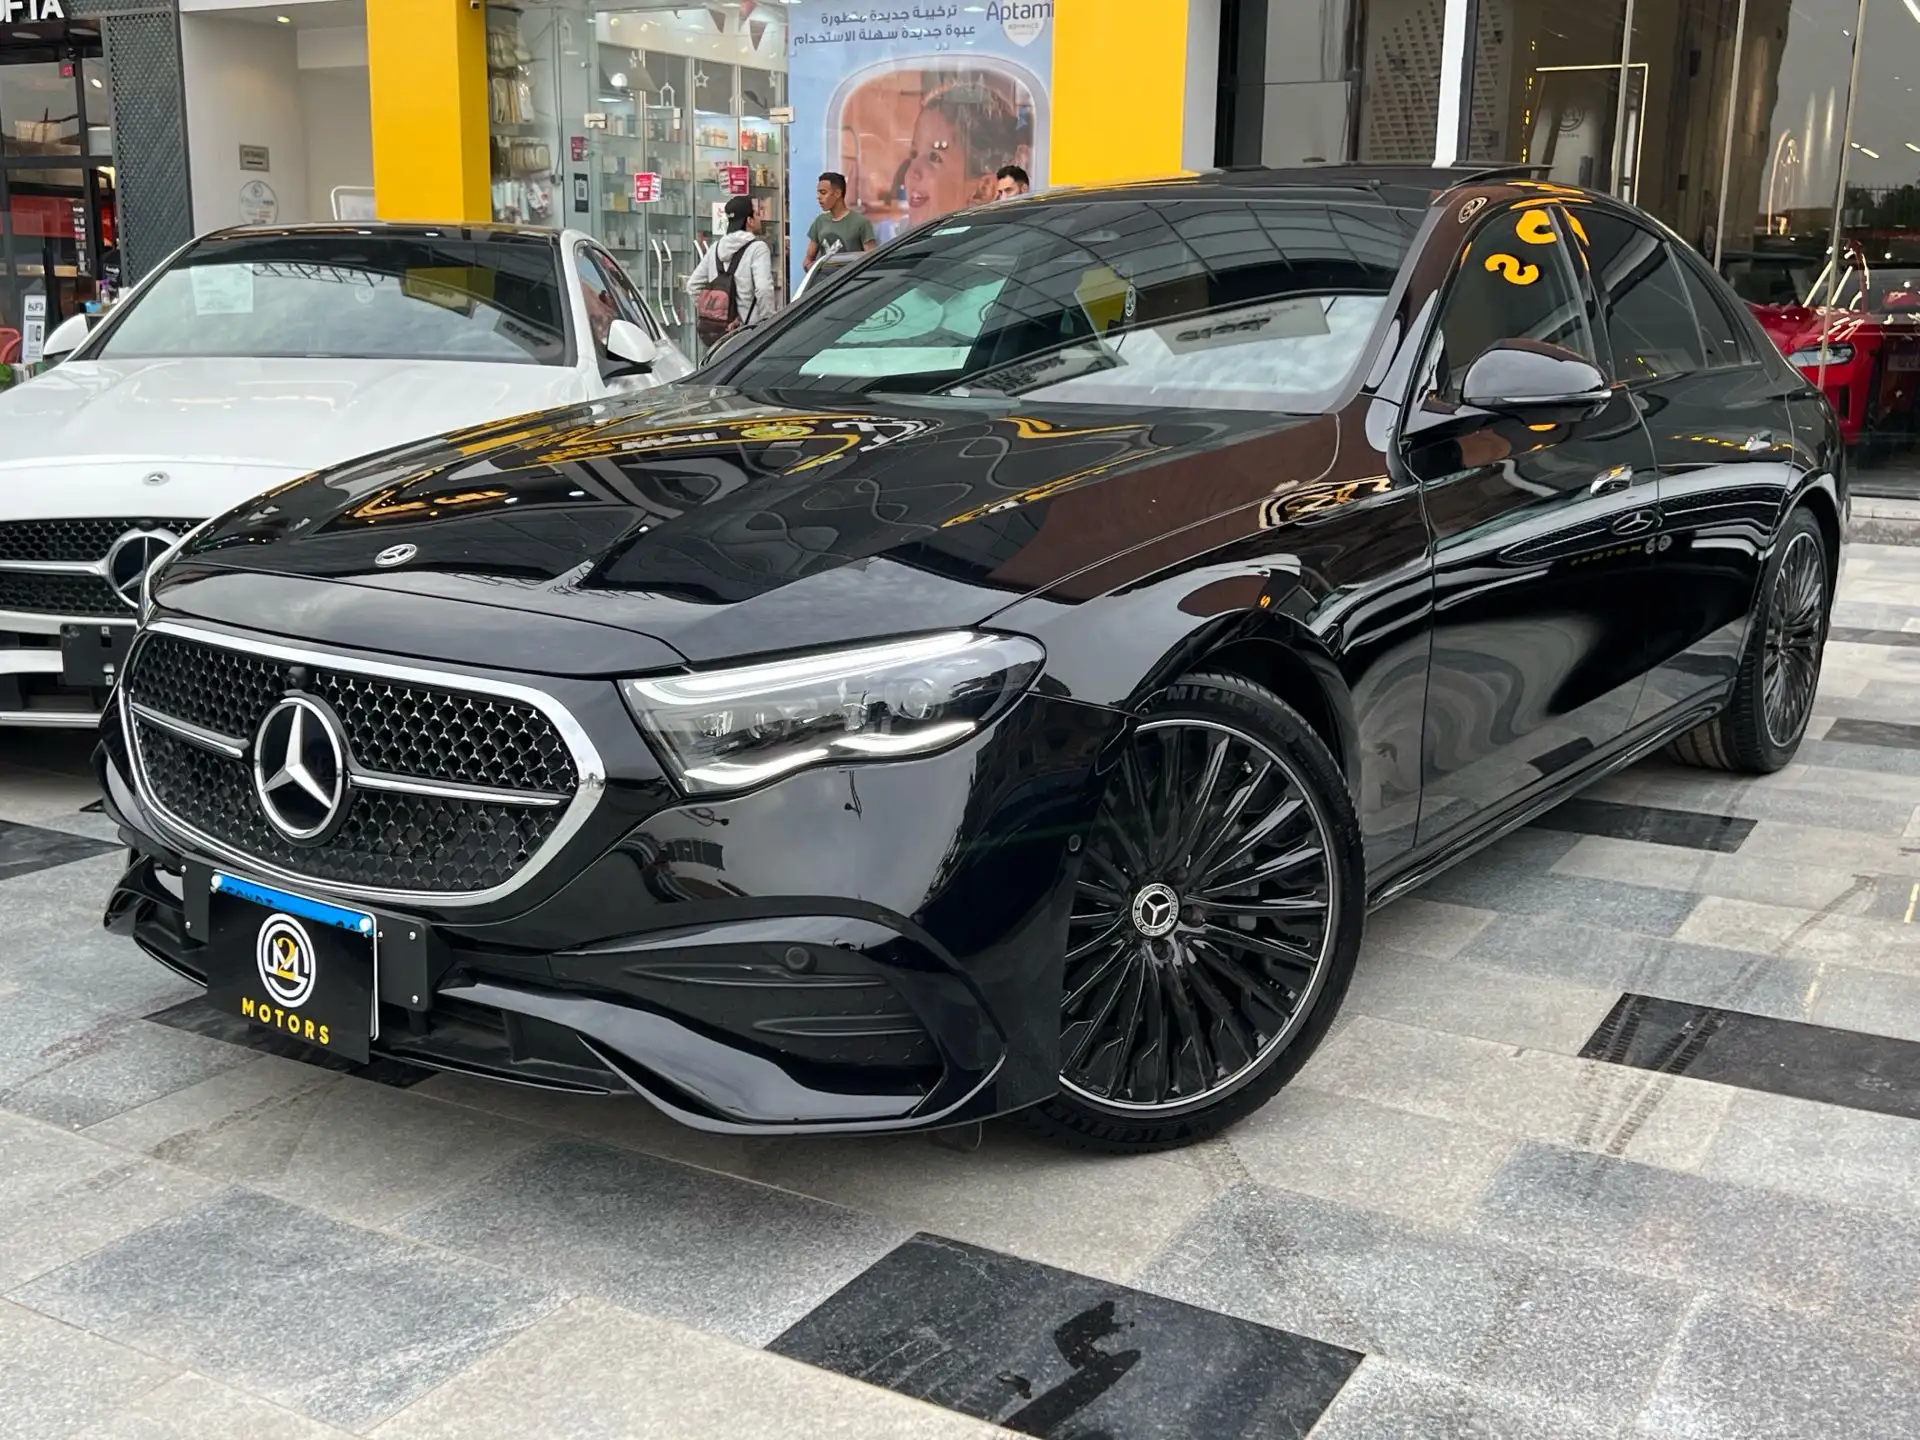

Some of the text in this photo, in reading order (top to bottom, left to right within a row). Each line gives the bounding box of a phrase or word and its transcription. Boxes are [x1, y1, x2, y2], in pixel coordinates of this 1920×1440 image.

[0, 0, 64, 22] FIA
[870, 9, 910, 24] جديدة
[912, 4, 957, 20] تركيبة
[794, 24, 976, 46] عبوة جديدة سهلة الاستخدام
[242, 997, 329, 1045] MOTORS
